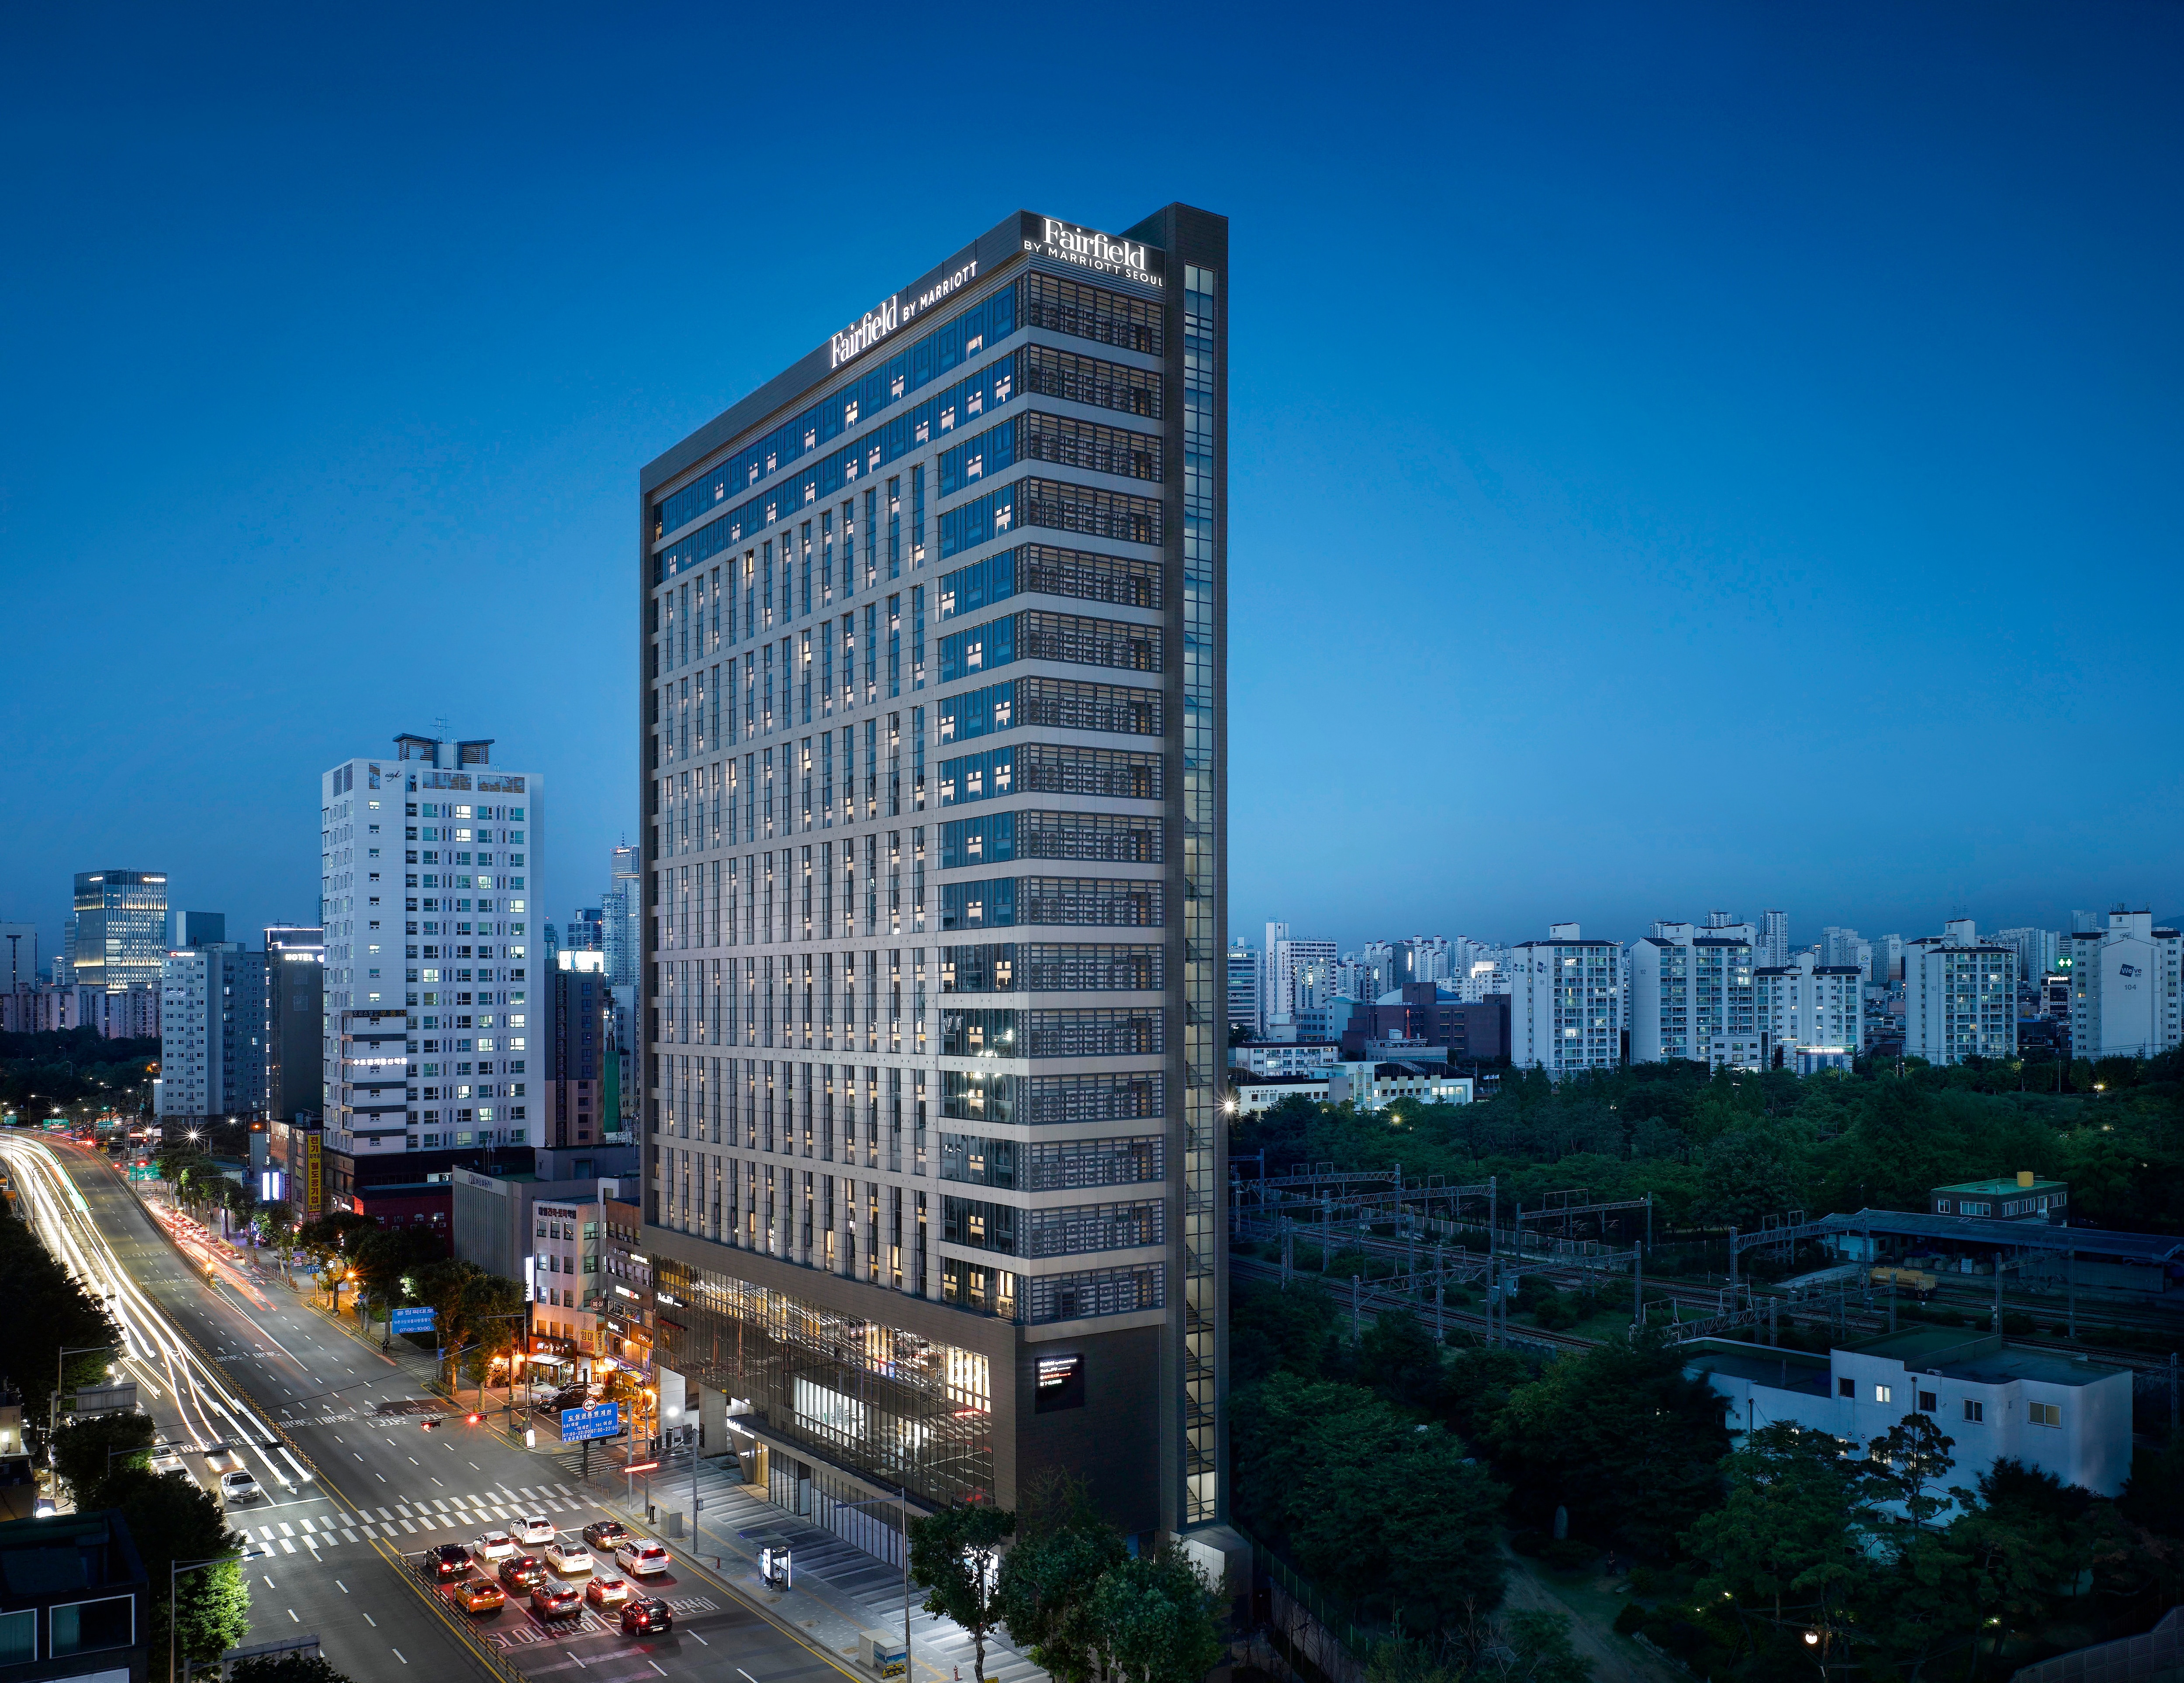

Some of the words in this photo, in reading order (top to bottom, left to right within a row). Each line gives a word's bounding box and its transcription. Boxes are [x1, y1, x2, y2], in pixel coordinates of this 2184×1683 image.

[1043, 217, 1146, 271] Fairfield
[1023, 241, 1041, 252] BY
[1048, 247, 1120, 274] MARRIOTT
[1125, 269, 1163, 286] SEOUL
[831, 294, 899, 369] Fairfield
[903, 301, 917, 322] BY
[920, 260, 978, 310] MARRIOTT
[311, 1136, 318, 1152] 전기
[311, 1162, 319, 1204] 철도공기업
[581, 1331, 593, 1341] 임대
[214, 1354, 246, 1362] 여의도
[364, 1409, 400, 1419] 영등포
[406, 1405, 444, 1414] 영등포
[568, 1409, 612, 1421] 도심권통행제한
[279, 1418, 316, 1428] 여의도
[321, 1414, 358, 1424] 여의도
[485, 1626, 549, 1649] SLOW
